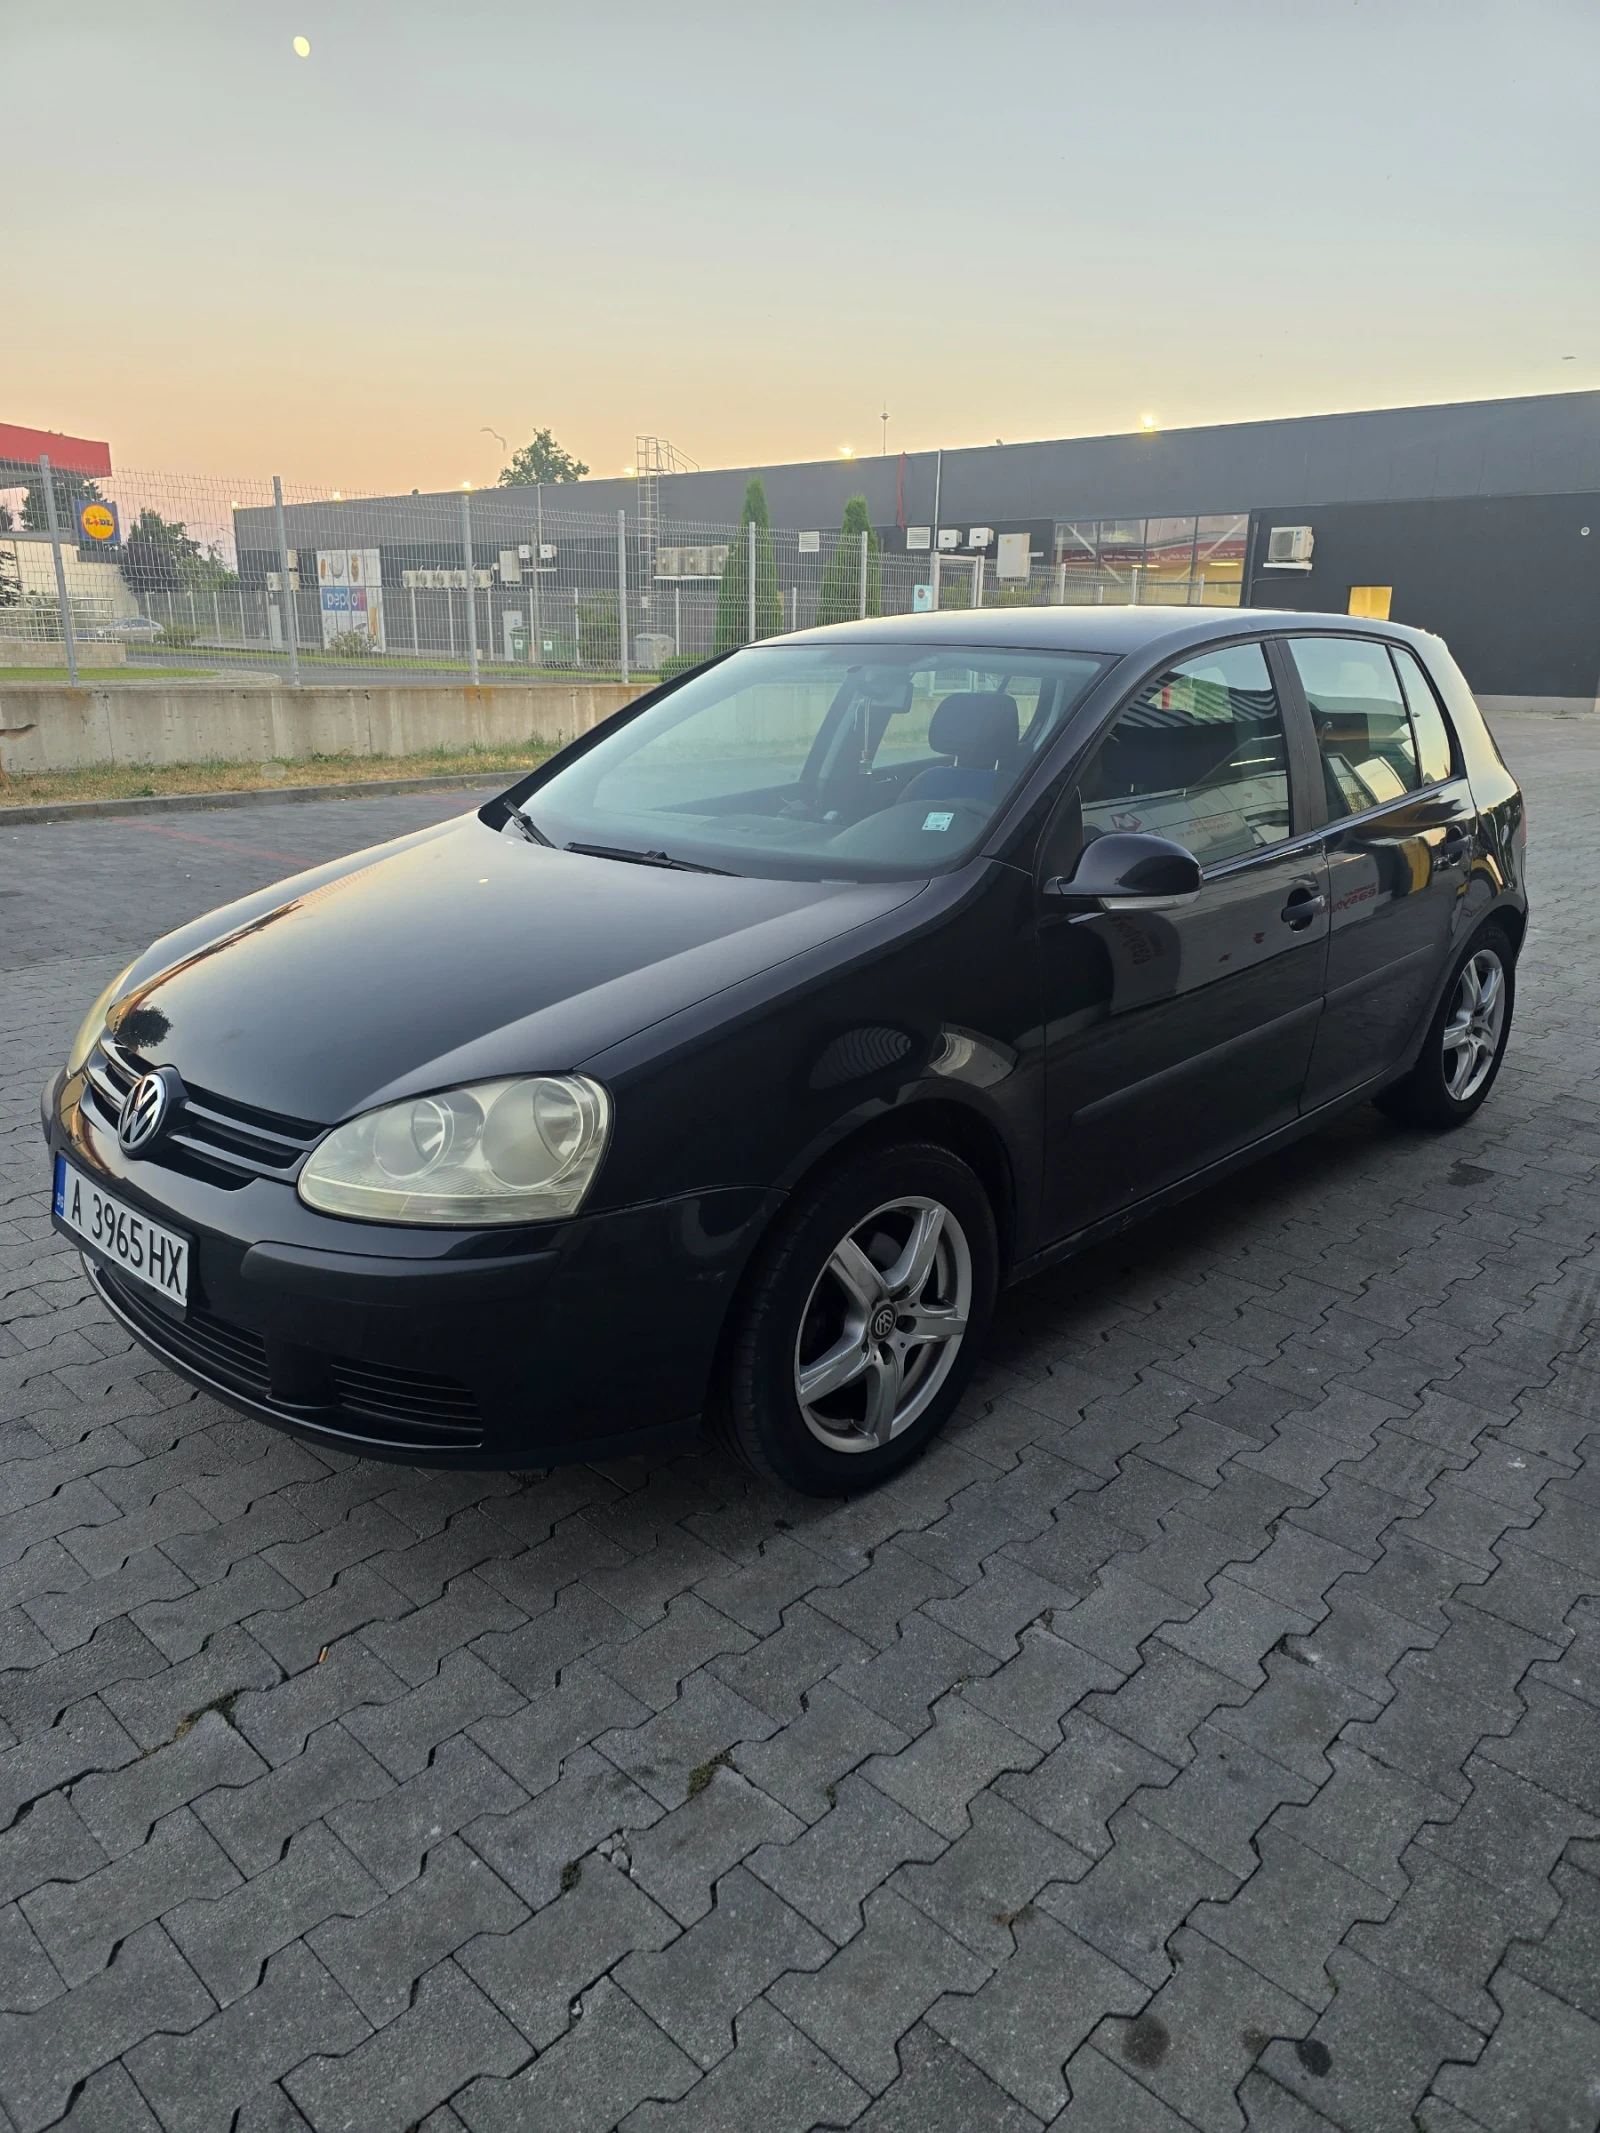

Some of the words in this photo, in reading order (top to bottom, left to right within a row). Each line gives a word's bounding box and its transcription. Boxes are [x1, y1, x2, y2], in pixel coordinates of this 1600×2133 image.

[85, 515, 113, 527] LIDL
[71, 1178, 82, 1226] A
[92, 1193, 144, 1268] 3965
[149, 1229, 183, 1296] HX
